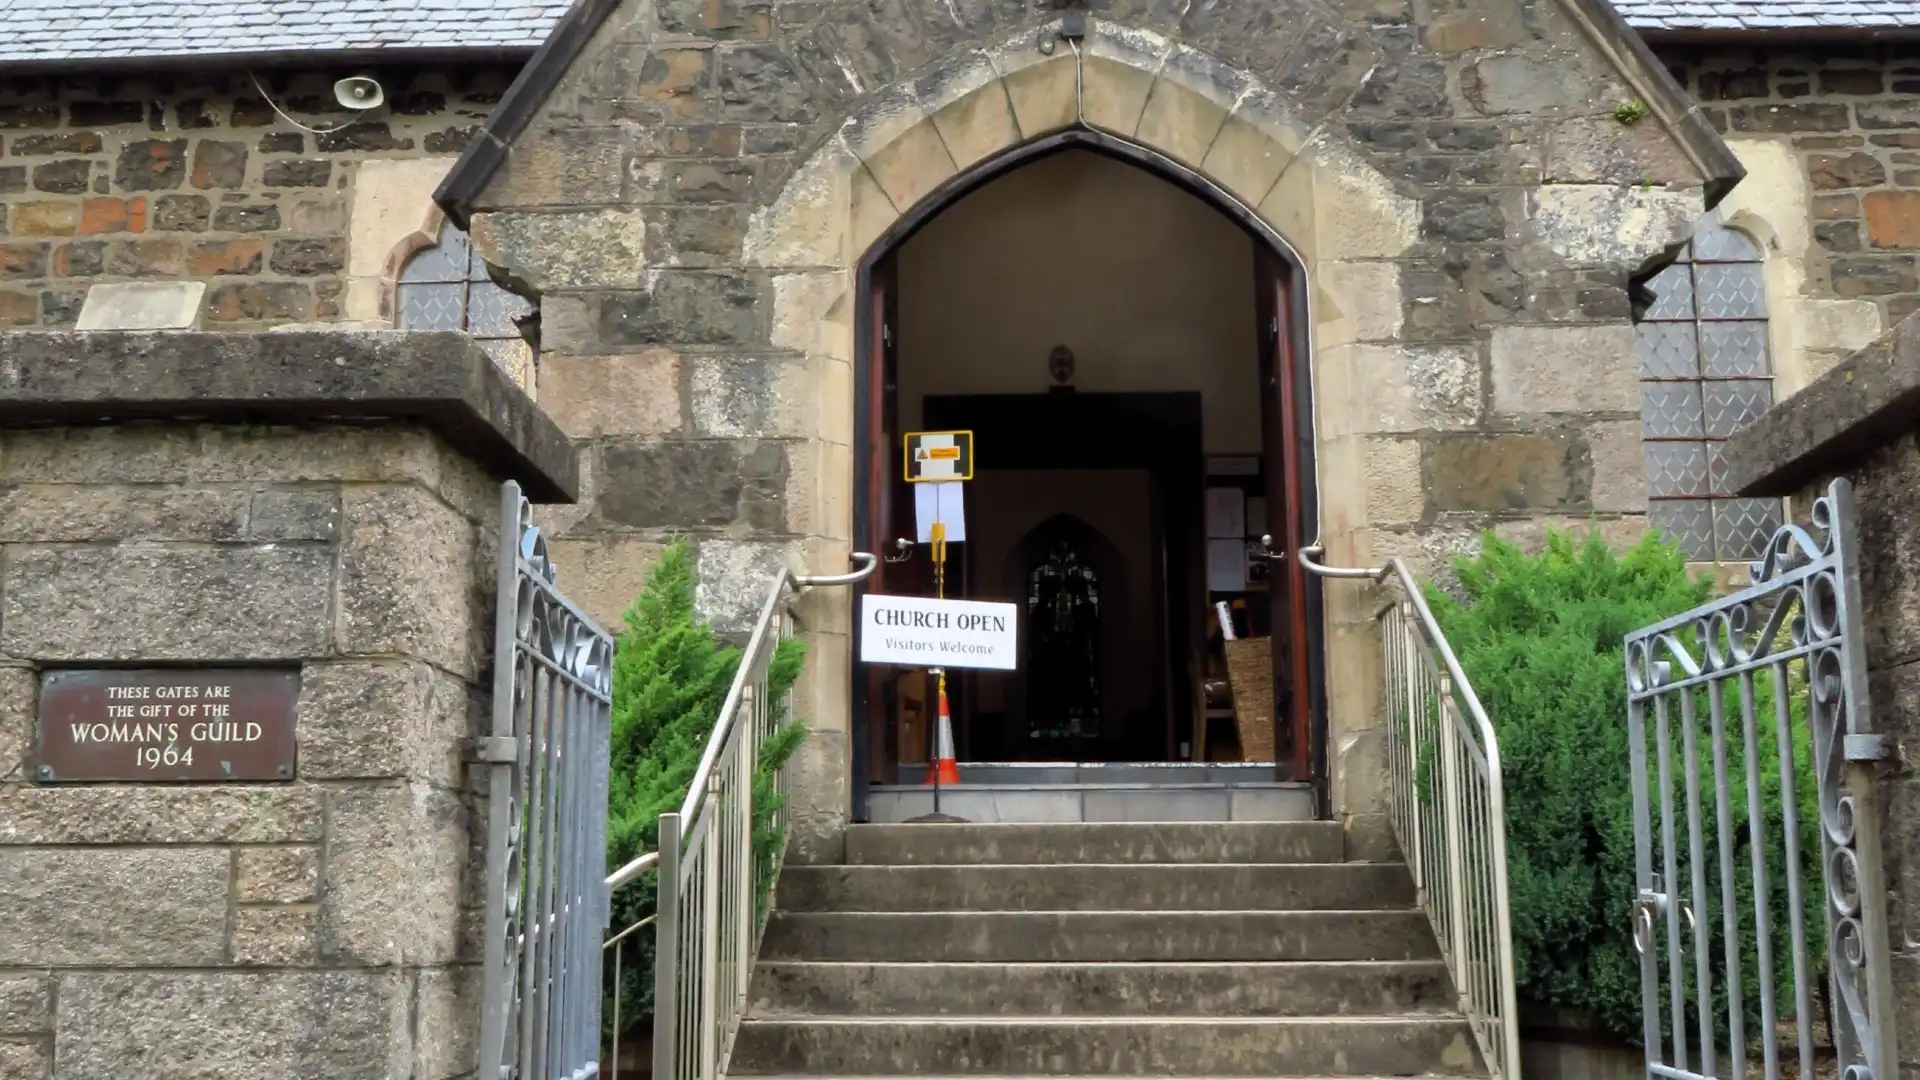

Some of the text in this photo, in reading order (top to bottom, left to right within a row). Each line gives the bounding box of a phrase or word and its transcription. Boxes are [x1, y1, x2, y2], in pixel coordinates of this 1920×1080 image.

[874, 608, 1005, 632] CHURCH OPEN
[885, 638, 994, 655] Visitors Welcome
[109, 686, 230, 699] THESE GATES ARE
[108, 704, 229, 718] THE GIFT OF THE
[71, 722, 262, 743] WOMAN'S GUILD
[136, 745, 193, 770] 1964
